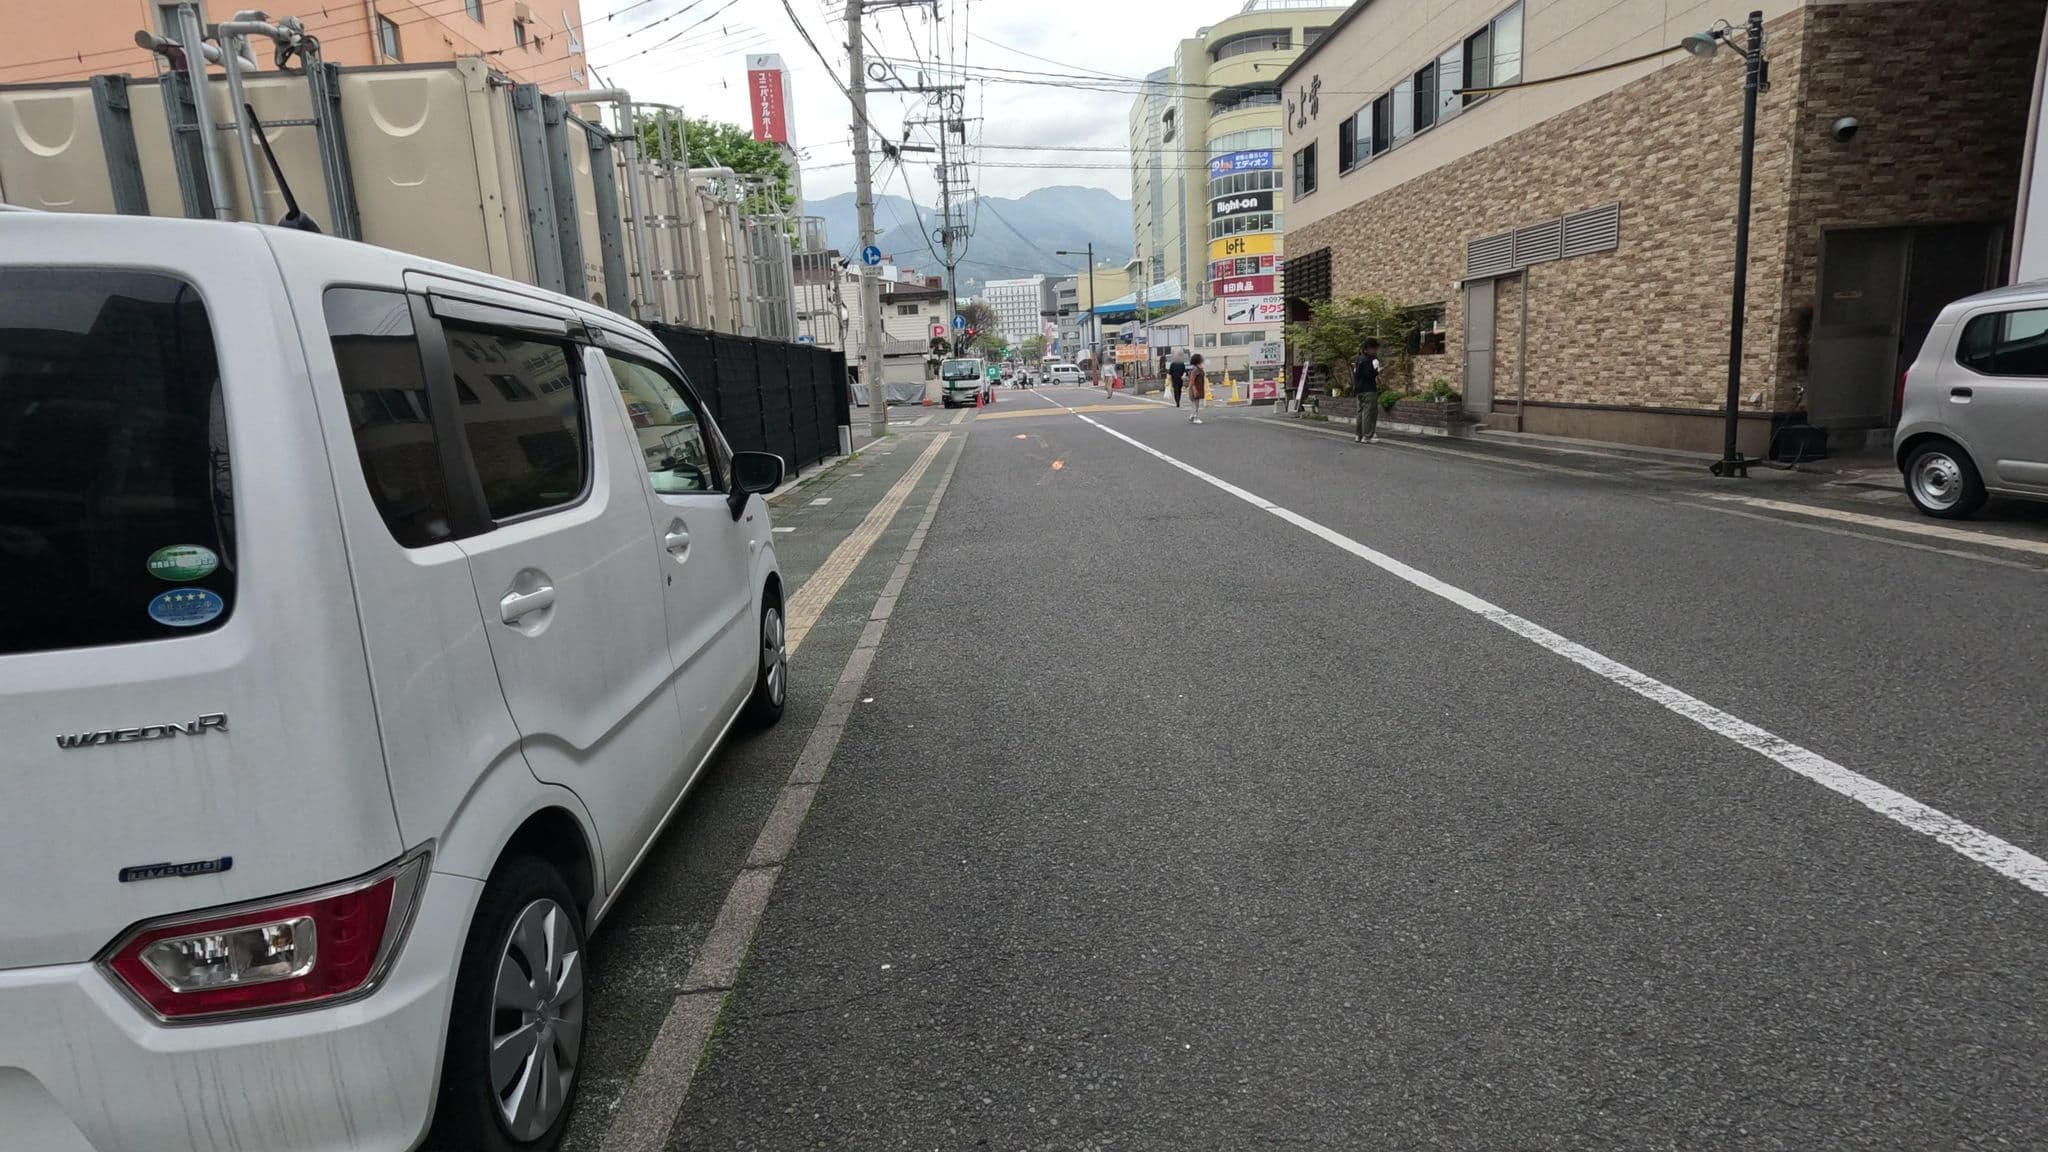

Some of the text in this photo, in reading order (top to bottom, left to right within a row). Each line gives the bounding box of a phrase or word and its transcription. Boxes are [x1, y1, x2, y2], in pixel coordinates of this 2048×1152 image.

[1235, 158, 1269, 169] エディオン
[933, 325, 944, 337] P
